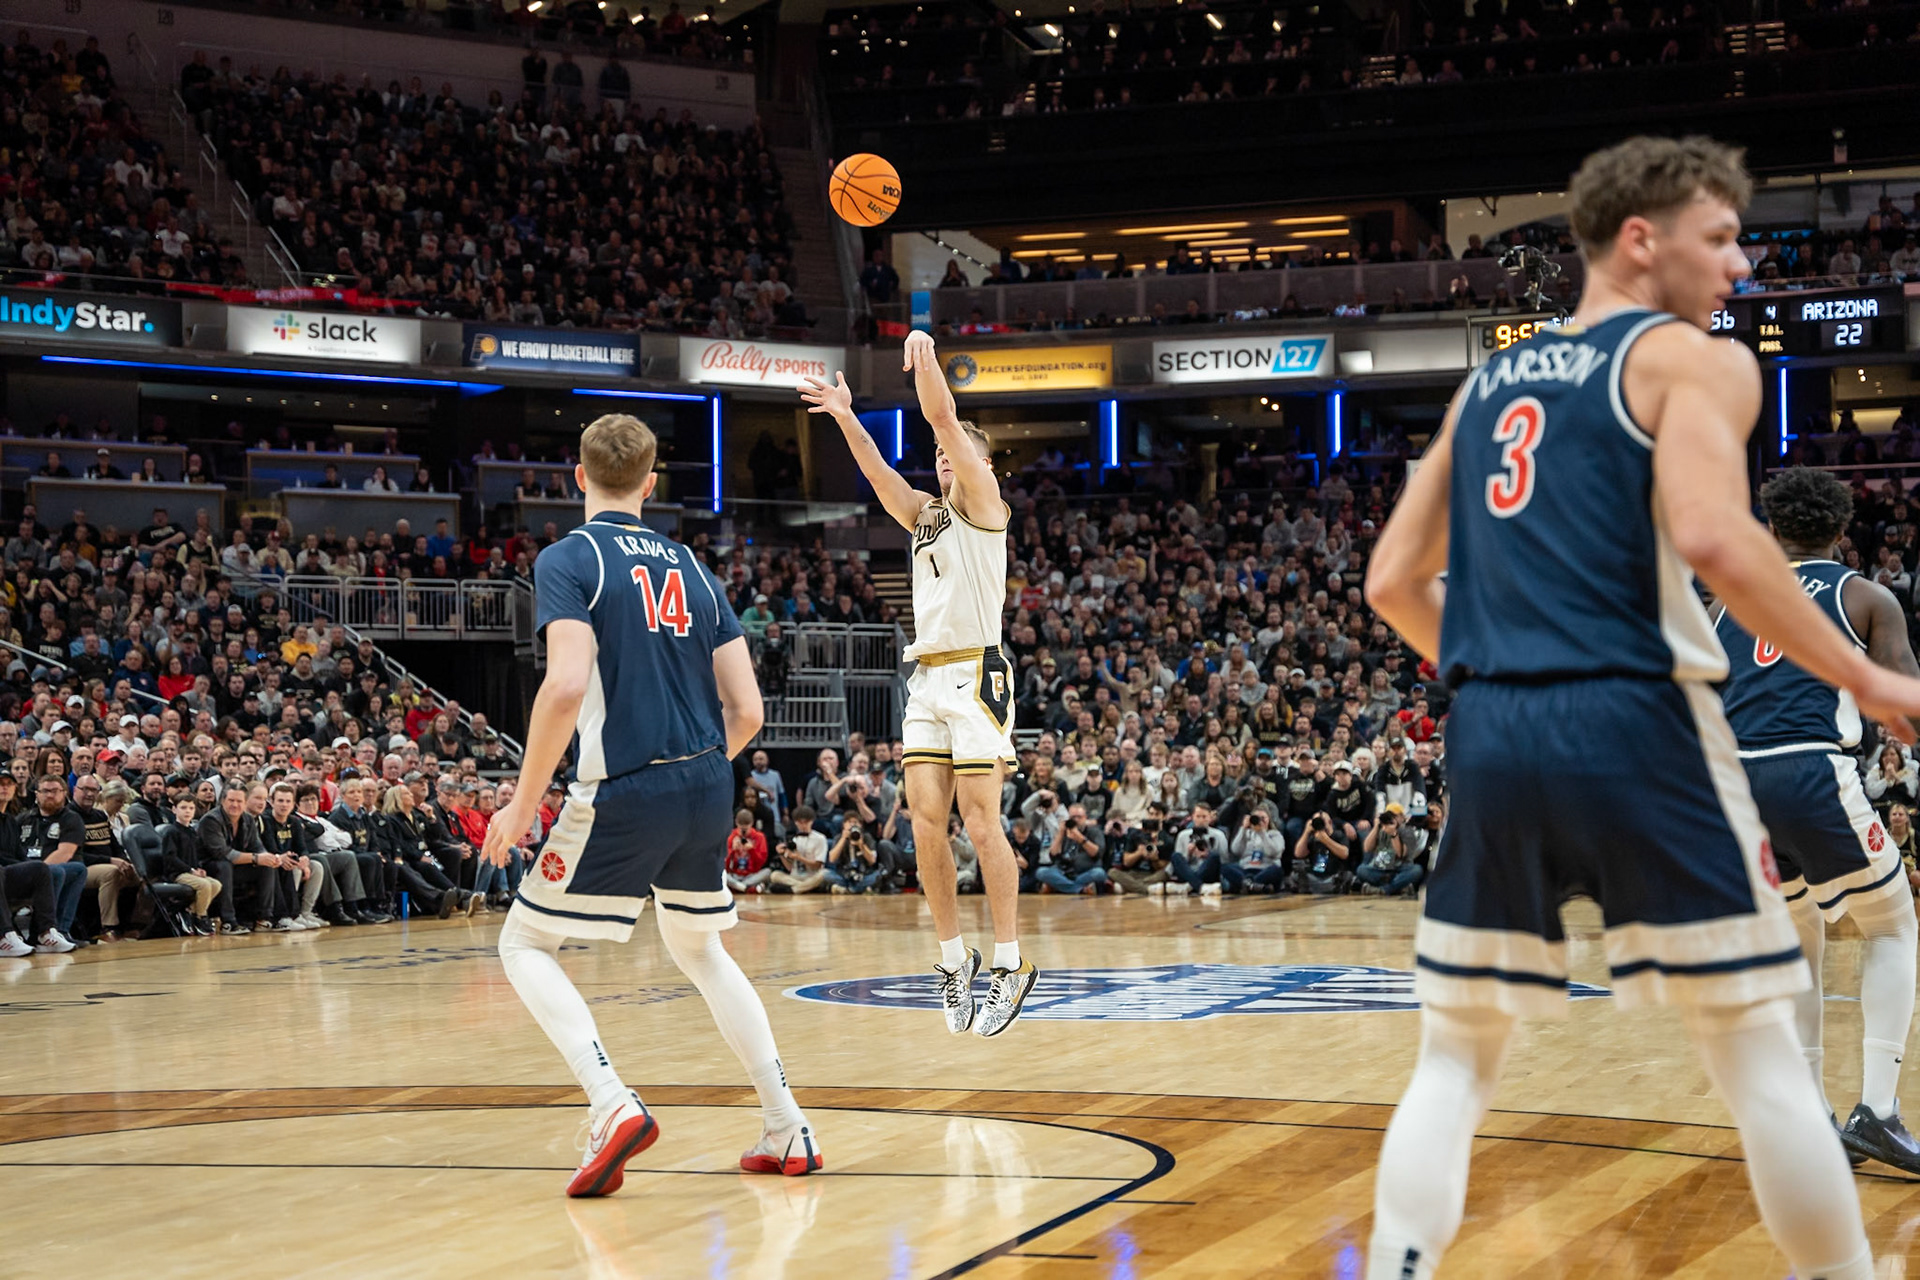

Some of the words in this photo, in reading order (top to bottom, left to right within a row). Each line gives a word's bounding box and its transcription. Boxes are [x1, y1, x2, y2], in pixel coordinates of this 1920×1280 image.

[1765, 305, 1777, 320] 4
[1802, 299, 1879, 321] ARIZONA
[307, 316, 377, 343] slack
[1835, 323, 1863, 346] 22
[501, 340, 519, 358] WE
[519, 342, 550, 360] GROW
[551, 344, 609, 363] BASKETBALL
[610, 347, 635, 365] HERE
[701, 341, 772, 380] Bally
[774, 358, 826, 377] SPORTS
[1158, 348, 1272, 372] SECTION
[1278, 345, 1317, 369] 127
[1478, 341, 1608, 400] LARSSON
[1485, 396, 1546, 519] 3
[613, 535, 680, 565] KRIVAS
[929, 553, 940, 578] 1
[630, 564, 693, 637] 14
